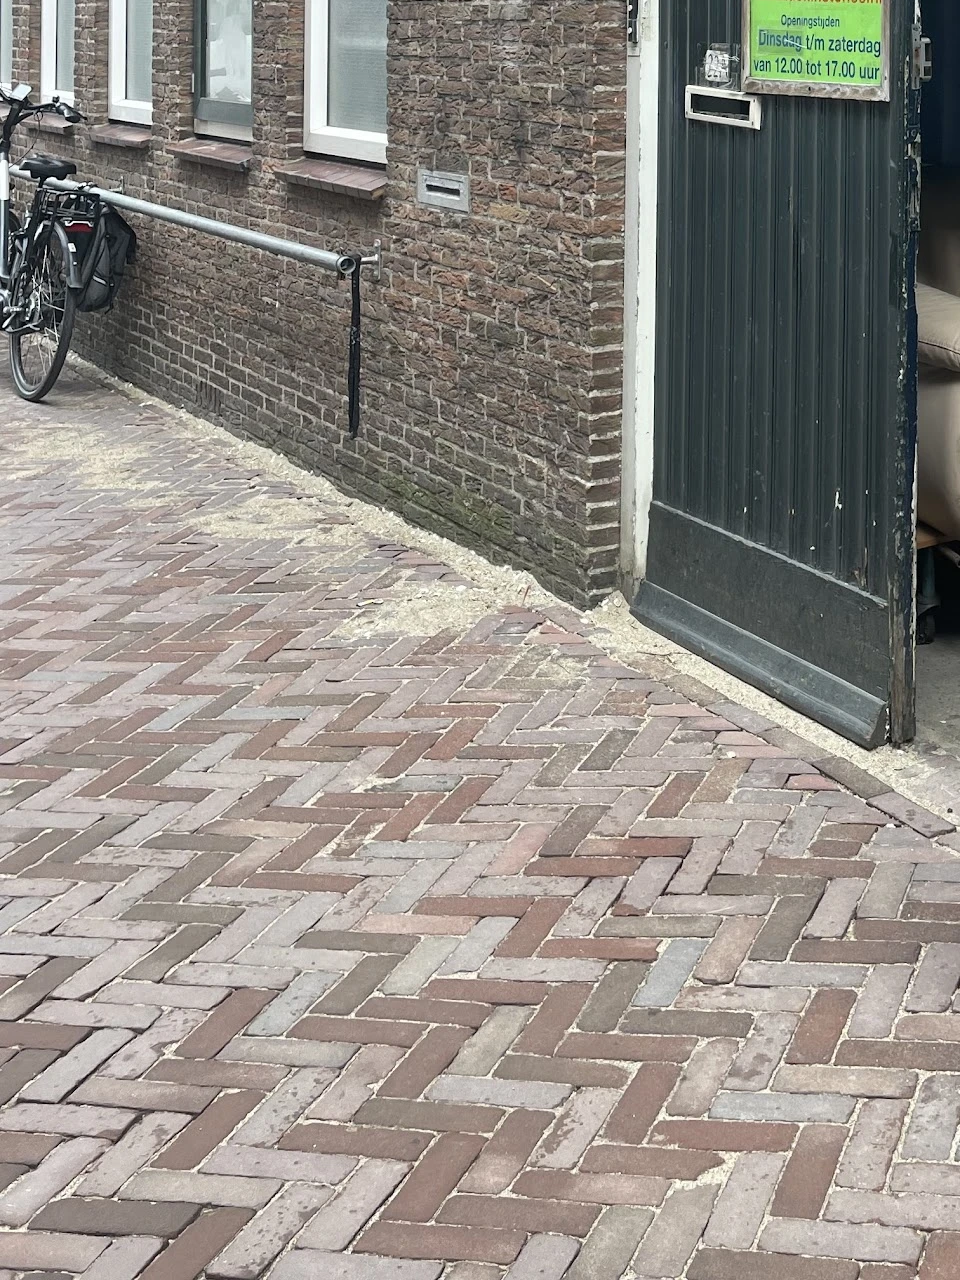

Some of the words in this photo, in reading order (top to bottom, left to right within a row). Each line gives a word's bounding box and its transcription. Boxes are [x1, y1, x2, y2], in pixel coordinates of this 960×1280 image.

[781, 14, 840, 30] Openingstijden
[758, 29, 802, 50] Dinsdag
[806, 34, 825, 51] t/m
[828, 37, 881, 57] zaterdag
[753, 60, 772, 72] van
[775, 57, 802, 74] 12.00
[806, 61, 822, 76] tot
[825, 62, 856, 79] 17.00
[859, 66, 880, 80] uur
